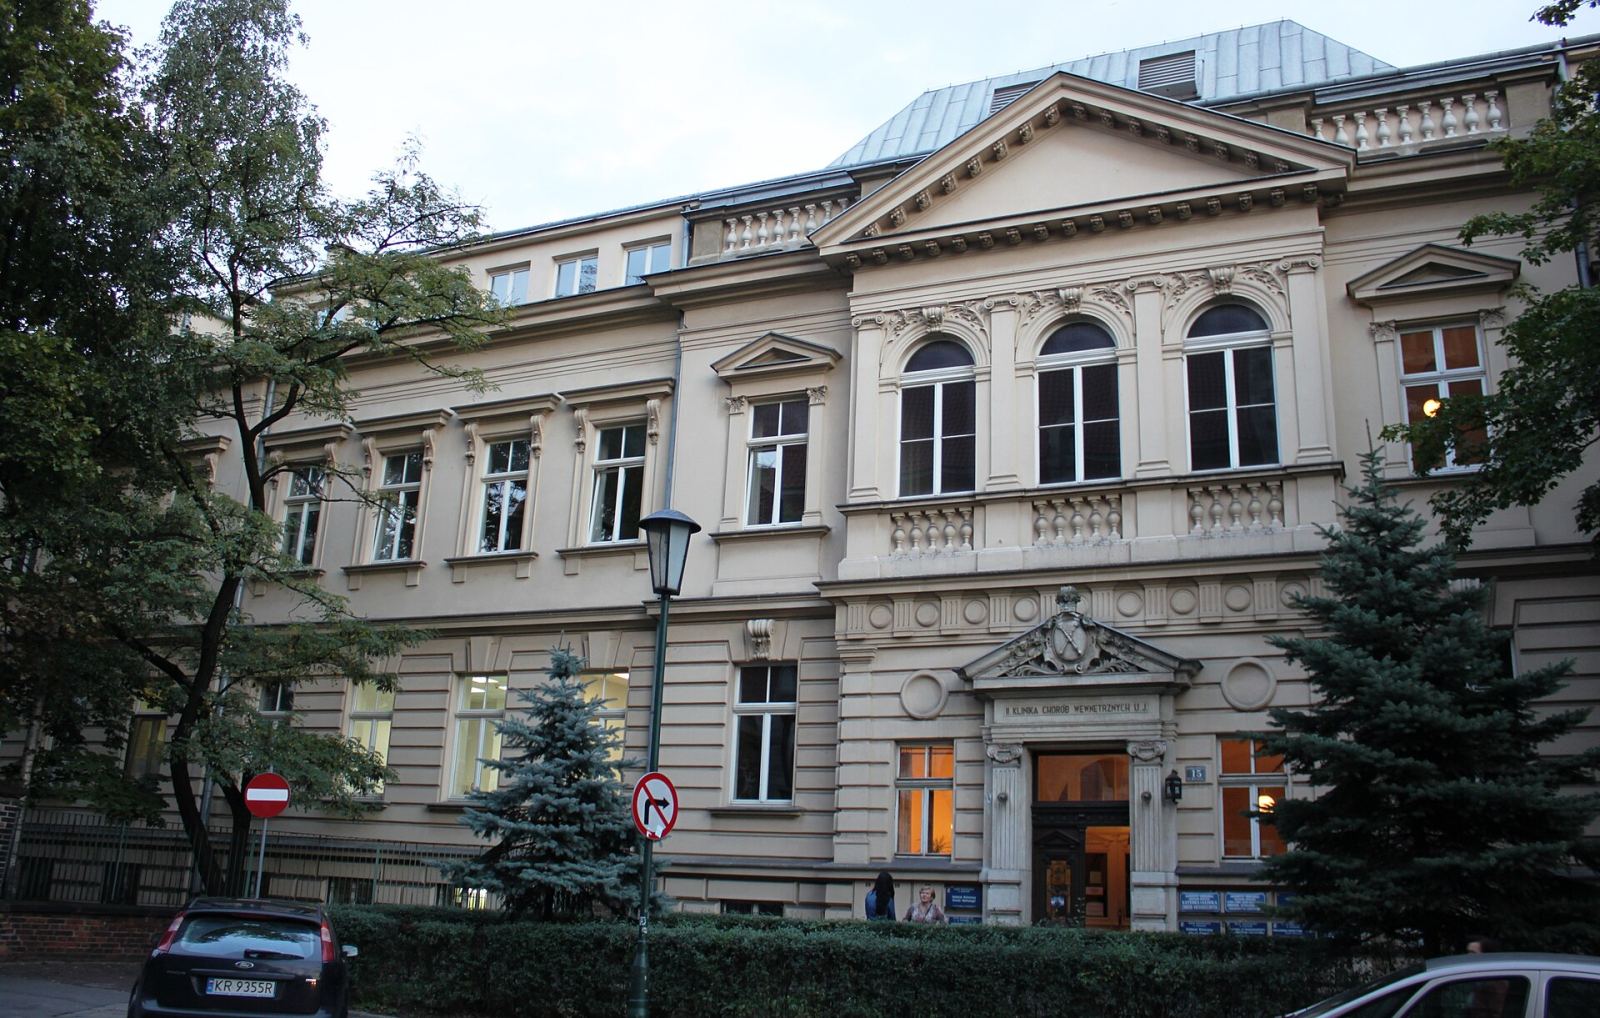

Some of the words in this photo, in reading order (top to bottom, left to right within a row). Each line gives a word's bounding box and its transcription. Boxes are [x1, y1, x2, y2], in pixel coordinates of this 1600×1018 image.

[1012, 706, 1039, 715] KLINIKA
[1192, 769, 1202, 778] 15
[215, 980, 232, 992] KR
[236, 981, 273, 993] 9355R
